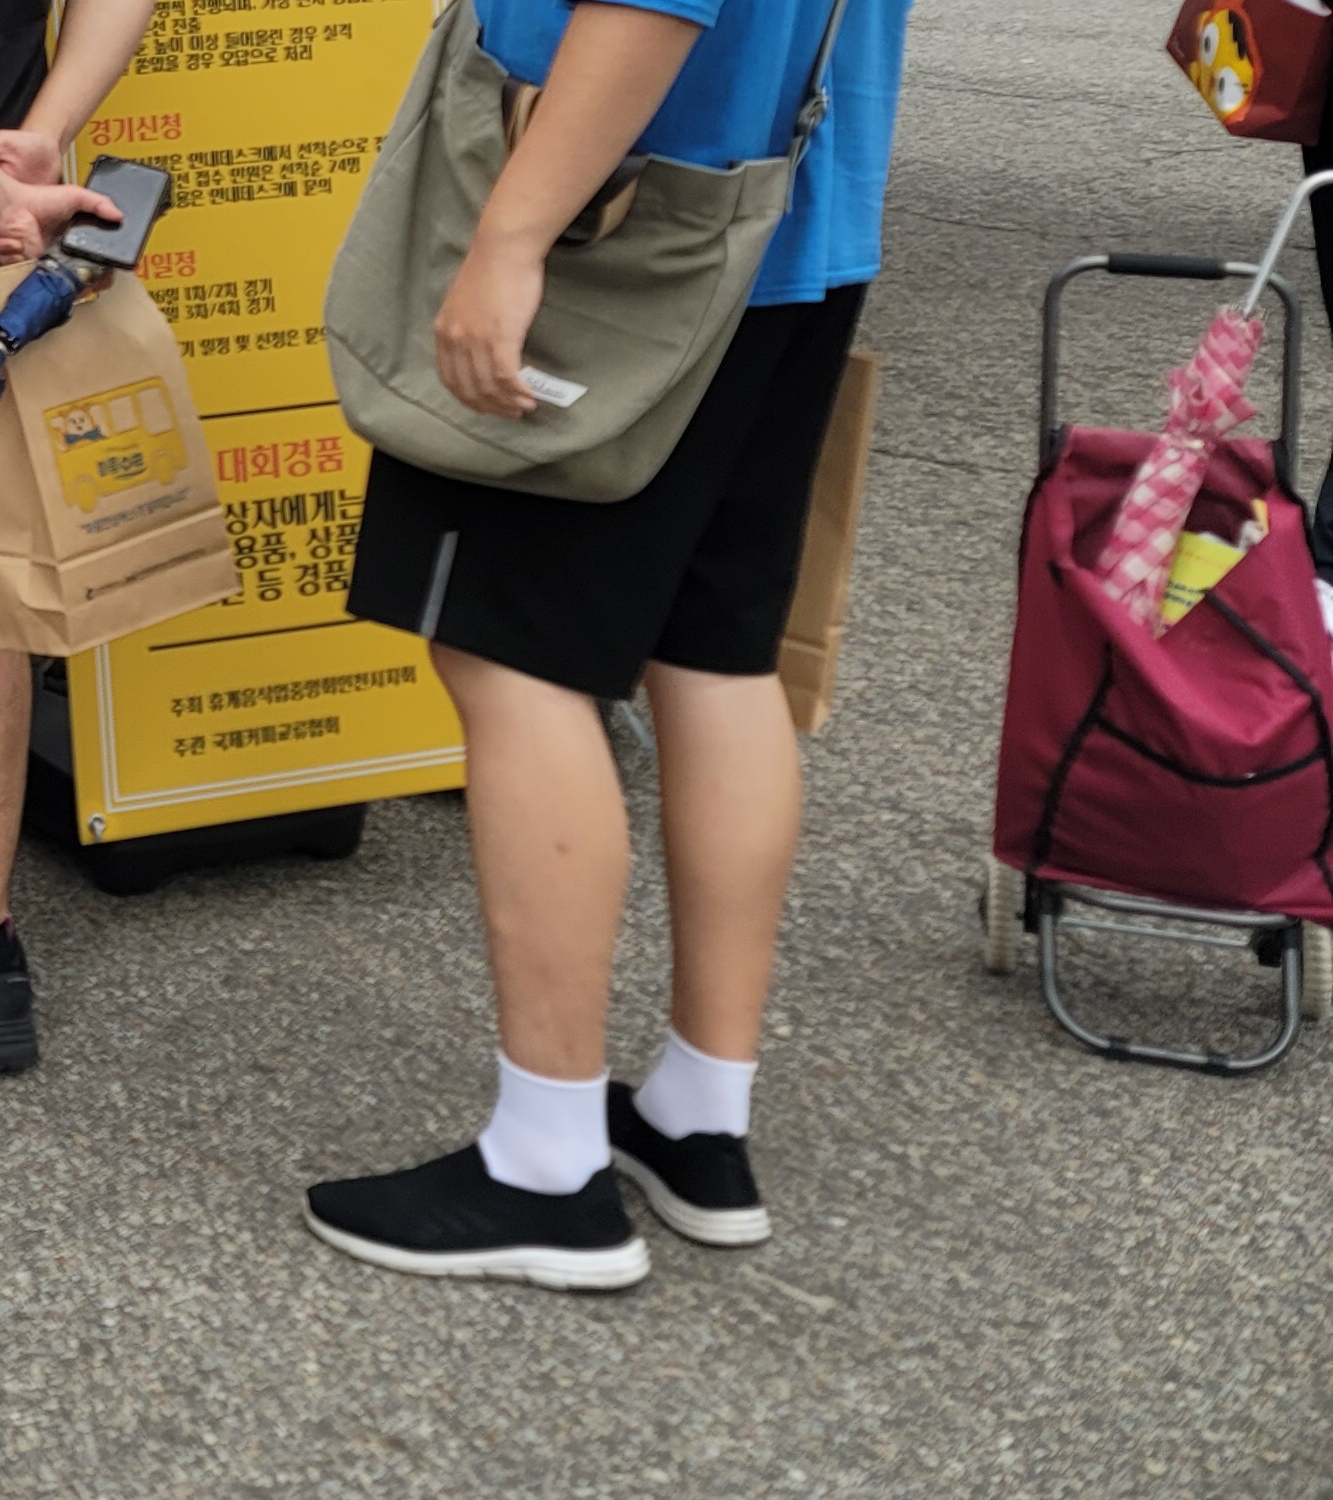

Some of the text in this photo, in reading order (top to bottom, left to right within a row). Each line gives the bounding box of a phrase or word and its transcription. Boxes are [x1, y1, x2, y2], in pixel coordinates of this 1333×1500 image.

[288, 23, 352, 43] 경우 실격
[219, 47, 278, 68] 오답으로
[89, 112, 182, 146] 경기신청
[244, 277, 273, 298] 경기
[246, 296, 275, 315] 경기
[216, 435, 346, 485] 대회경품
[224, 488, 364, 535] 상자에게는
[234, 522, 358, 570] 용품, 상품
[256, 560, 350, 602] 등 경품
[171, 695, 203, 718] 주최
[174, 735, 206, 758] 주관
